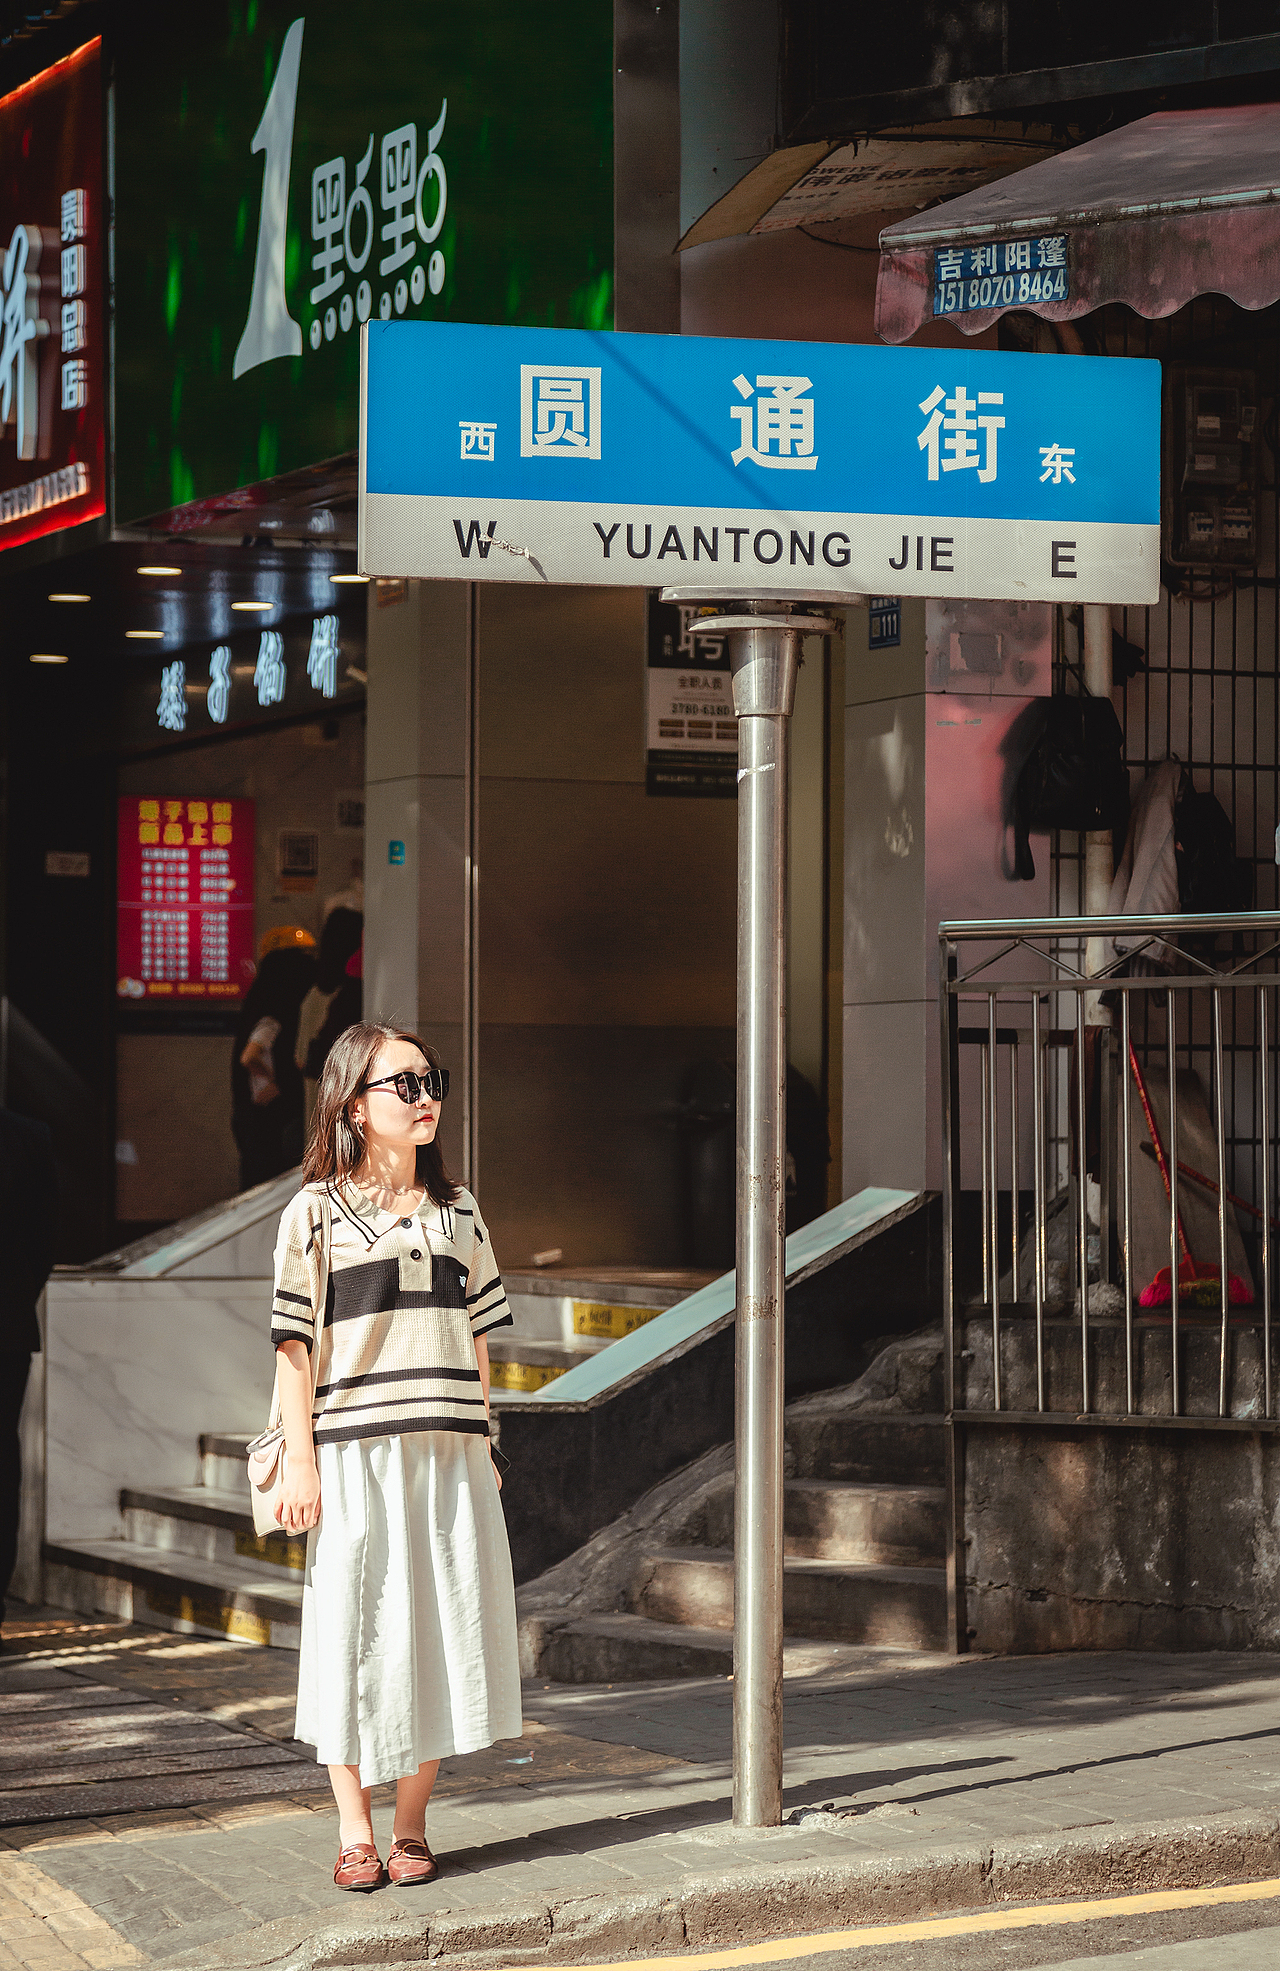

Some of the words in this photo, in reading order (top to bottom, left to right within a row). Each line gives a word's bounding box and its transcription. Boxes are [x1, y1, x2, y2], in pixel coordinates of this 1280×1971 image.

[937, 236, 1068, 281] 吉利阳篷
[938, 281, 965, 313] 151
[968, 275, 1015, 308] 8070
[1019, 268, 1066, 303] 8464
[458, 420, 498, 462] 西
[1038, 443, 1077, 484] 东
[452, 519, 498, 559] W
[592, 521, 852, 568] YUANTONG
[888, 534, 954, 573] JIE
[1051, 540, 1078, 579] E
[881, 612, 898, 638] 111
